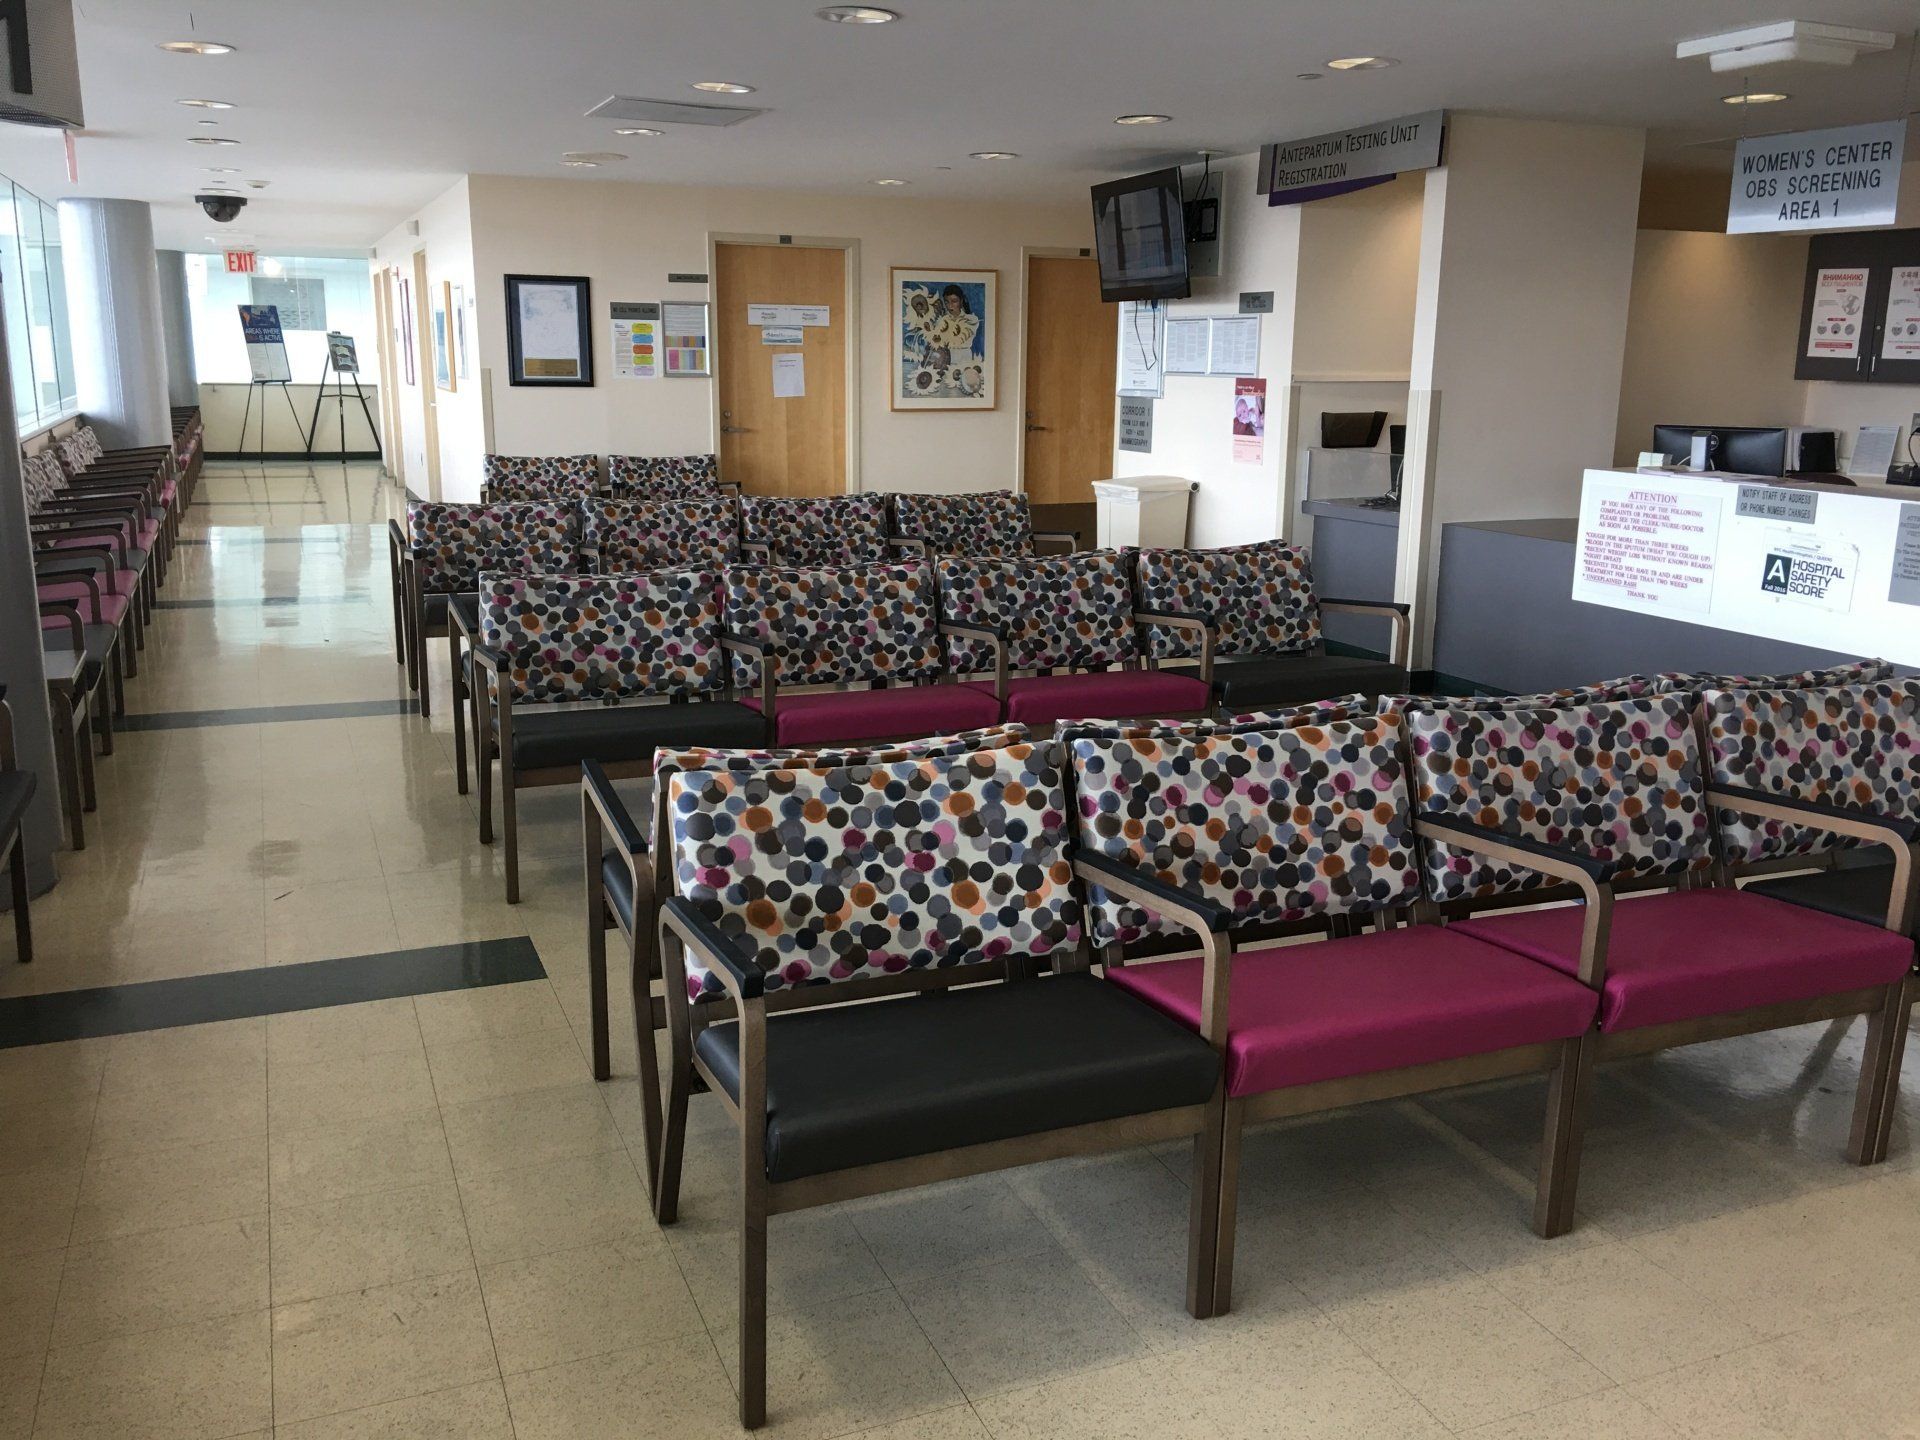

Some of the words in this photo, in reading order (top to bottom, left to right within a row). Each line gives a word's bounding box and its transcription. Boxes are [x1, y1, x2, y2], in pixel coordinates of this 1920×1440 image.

[1742, 149, 1815, 175] WOMEN'S
[1825, 141, 1893, 166] CENTER
[1746, 179, 1777, 198] OBS
[1787, 168, 1881, 194] SCREENING
[1778, 200, 1820, 221] AREA
[1832, 198, 1839, 217] 1
[227, 252, 255, 272] EXIT
[1122, 406, 1145, 416] CORRIDOR
[1628, 491, 1678, 504] ATTENTION
[1742, 489, 1760, 498] NOTIFY
[1762, 490, 1778, 500] STAFF
[1780, 492, 1787, 501] OF
[1789, 493, 1811, 504] ADDRESS
[1600, 508, 1632, 516] COMPLAINTS
[1670, 508, 1702, 518] FOLLOWING
[1740, 502, 1747, 511] OR
[1749, 503, 1765, 513] PHONE
[1767, 505, 1786, 516] NUMBER
[1788, 508, 1810, 519] CHANGES
[1624, 544, 1645, 553] SPUTUM
[1608, 549, 1627, 557] WEIGHT
[1642, 555, 1666, 563] WITHOUT
[1668, 558, 1688, 566] KNOWN
[1585, 566, 1613, 575] TREATMENT
[1767, 559, 1785, 583] A
[1792, 559, 1845, 580] HOSPITAL
[1586, 574, 1622, 585] UNEXPLAINED
[1684, 576, 1704, 584] UNDER
[1790, 570, 1832, 587] SAFETY
[1627, 590, 1645, 599] THANK
[1789, 582, 1825, 599] SCORE
